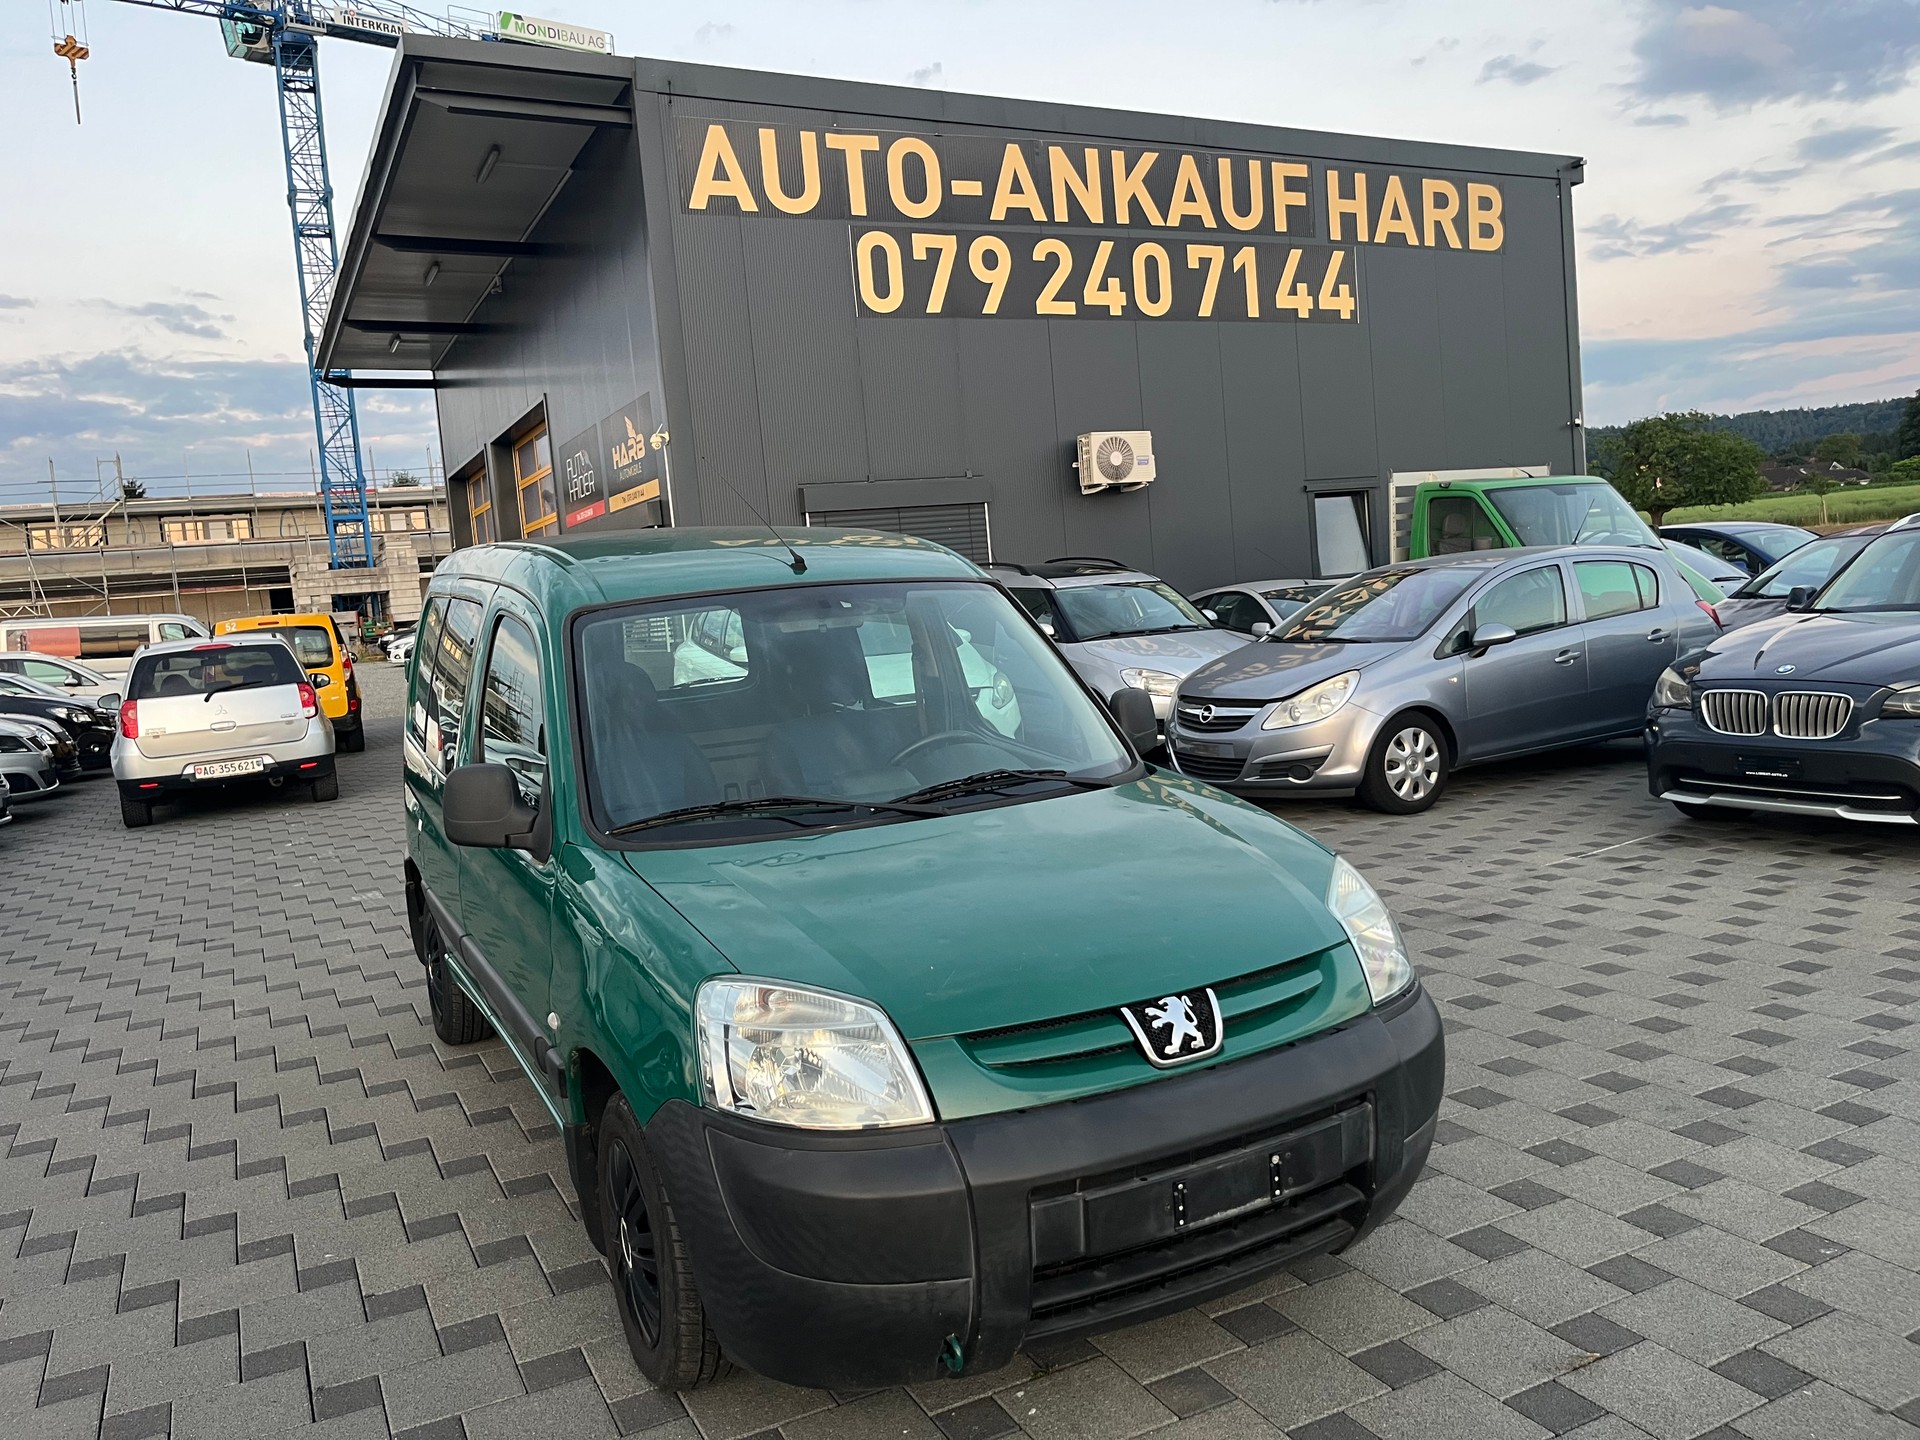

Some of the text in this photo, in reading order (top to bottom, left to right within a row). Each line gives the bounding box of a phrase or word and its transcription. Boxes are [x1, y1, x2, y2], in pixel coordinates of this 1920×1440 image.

[342, 15, 404, 35] INTERKRAN
[514, 21, 605, 48] MONDIBAU AG
[688, 124, 1504, 251] AUTO-ANKAUF HARB
[612, 433, 646, 470] HARB
[225, 622, 237, 632] 52
